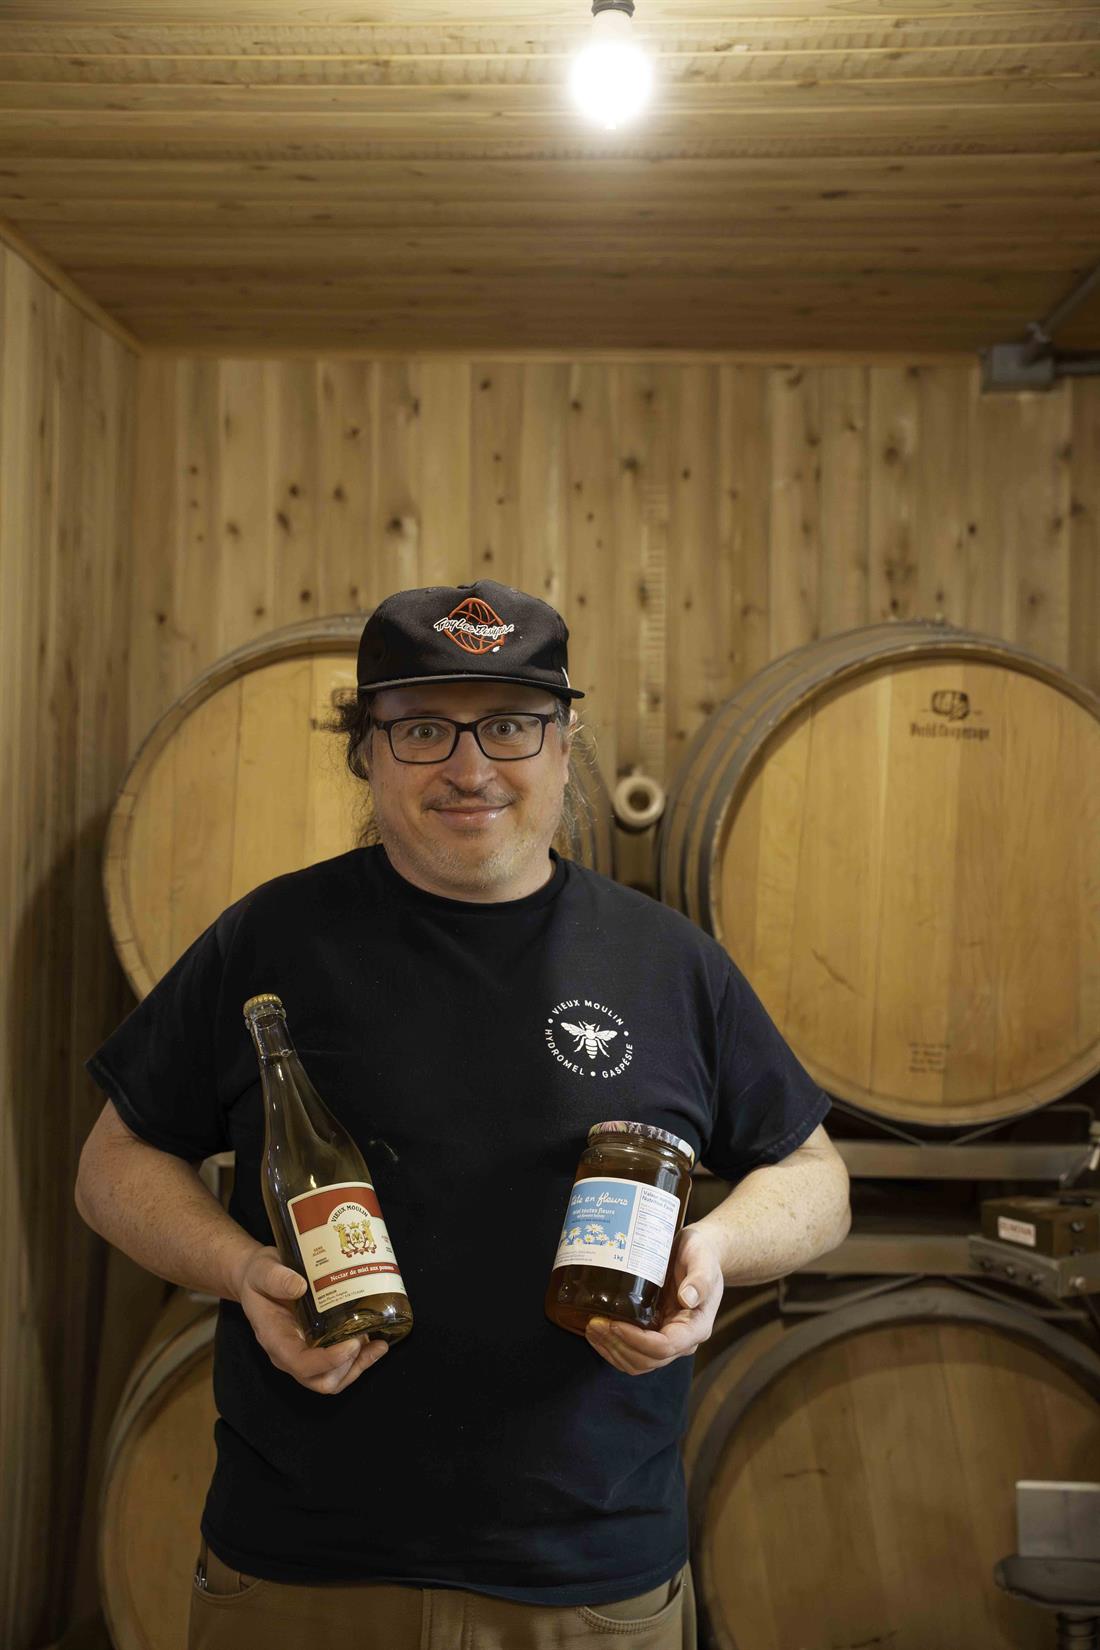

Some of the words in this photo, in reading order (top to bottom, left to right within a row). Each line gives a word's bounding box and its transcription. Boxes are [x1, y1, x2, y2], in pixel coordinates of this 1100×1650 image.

[552, 1000, 580, 1015] VIEUX
[584, 1000, 624, 1026] MOULIN
[545, 1029, 585, 1076] HYDROMEL
[602, 1043, 633, 1079] GASPÉSIE
[331, 1207, 347, 1222] VIEUX
[346, 1204, 368, 1217] MOULIN
[330, 1271, 349, 1282] Nectar
